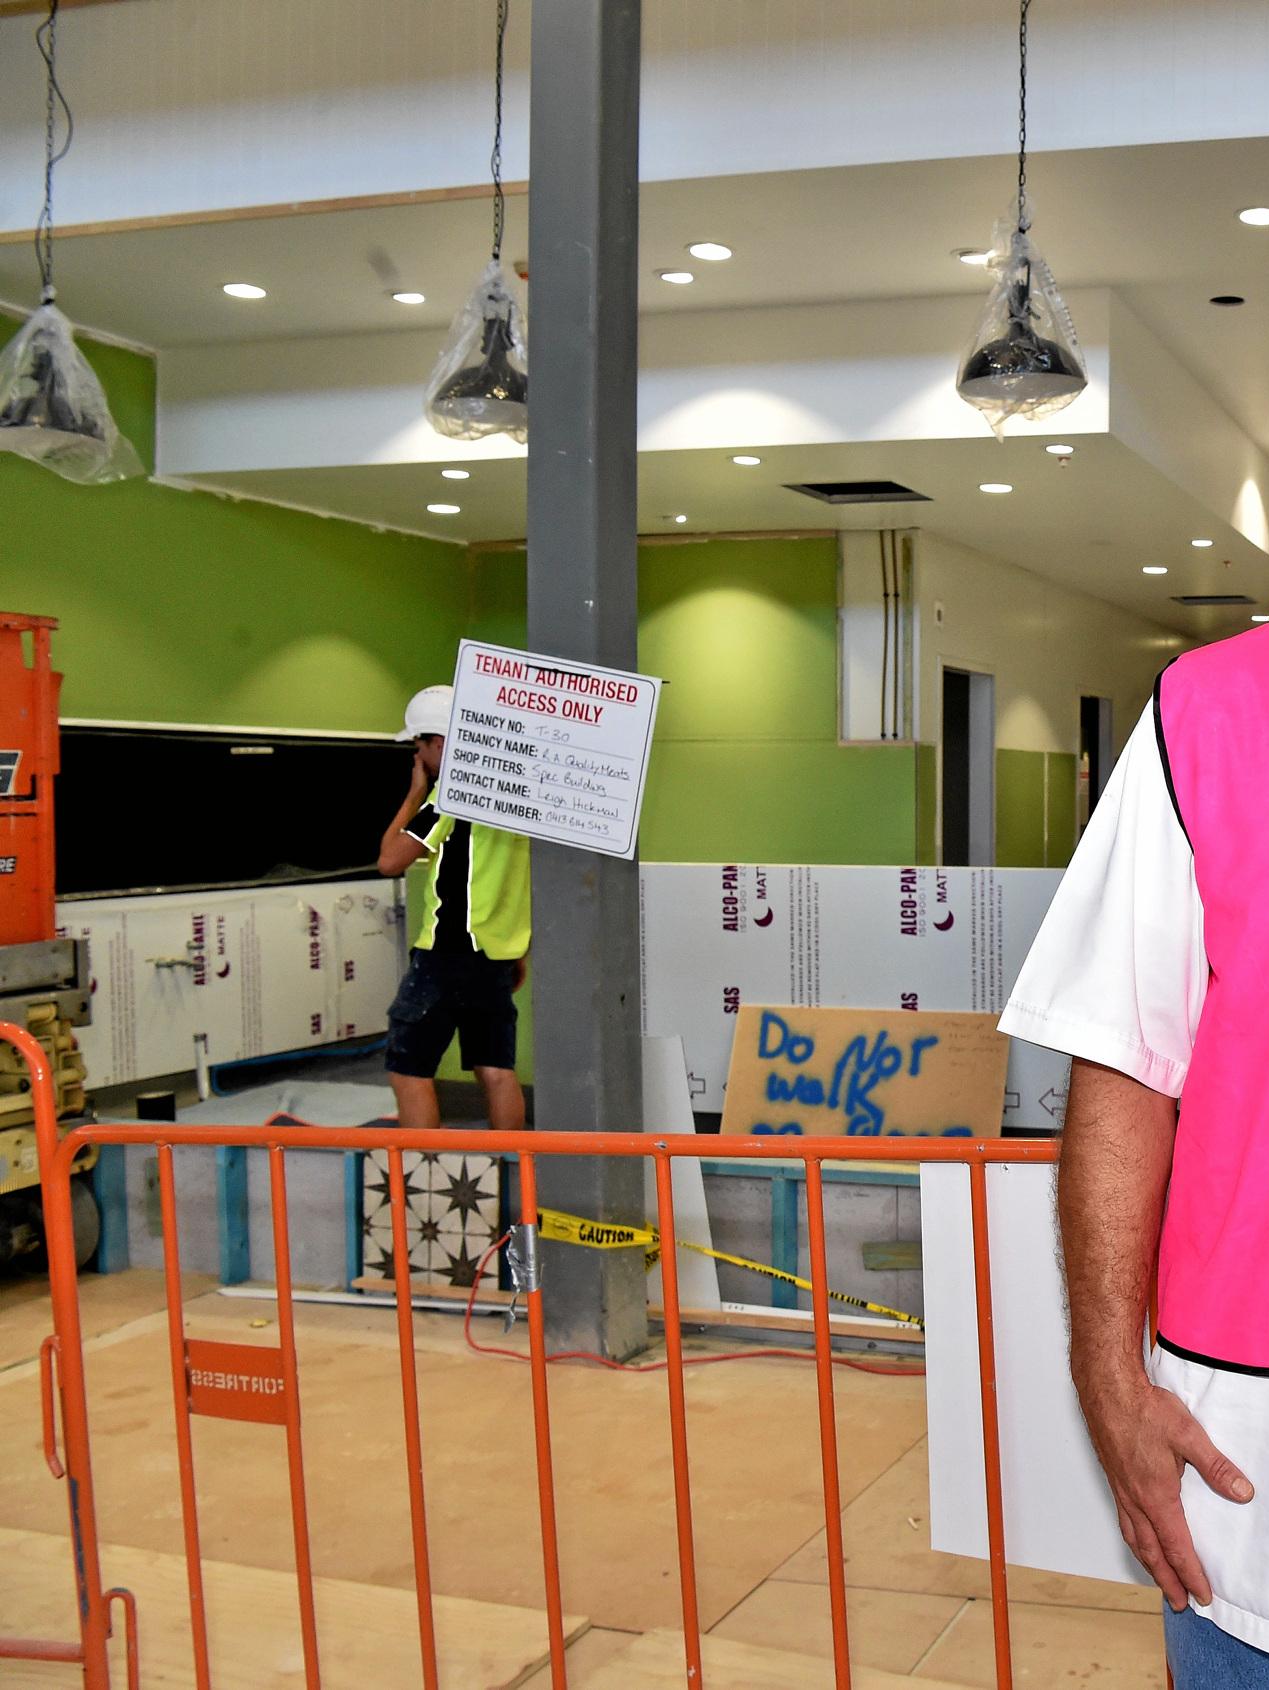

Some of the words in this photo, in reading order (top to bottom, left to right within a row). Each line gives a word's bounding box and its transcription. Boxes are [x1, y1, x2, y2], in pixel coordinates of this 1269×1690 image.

[475, 653, 530, 681] TENANT
[535, 668, 638, 703] AUTHORISED
[496, 686, 557, 714] ACCESS
[562, 699, 603, 723] ONLY
[460, 709, 506, 729] TENANCY
[507, 720, 526, 735] NO:
[457, 728, 502, 749] TENANCY
[504, 739, 539, 758] NAME:
[453, 748, 480, 764] SHOP
[481, 755, 526, 776] FITTERS:
[449, 768, 495, 789] CONTACT
[497, 779, 531, 798] NAME:
[446, 788, 492, 809] CONTACT
[493, 799, 542, 822] NUMBER:
[723, 987, 740, 1014] SAS
[758, 1010, 814, 1064] Do
[578, 1223, 634, 1244] CAUTION
